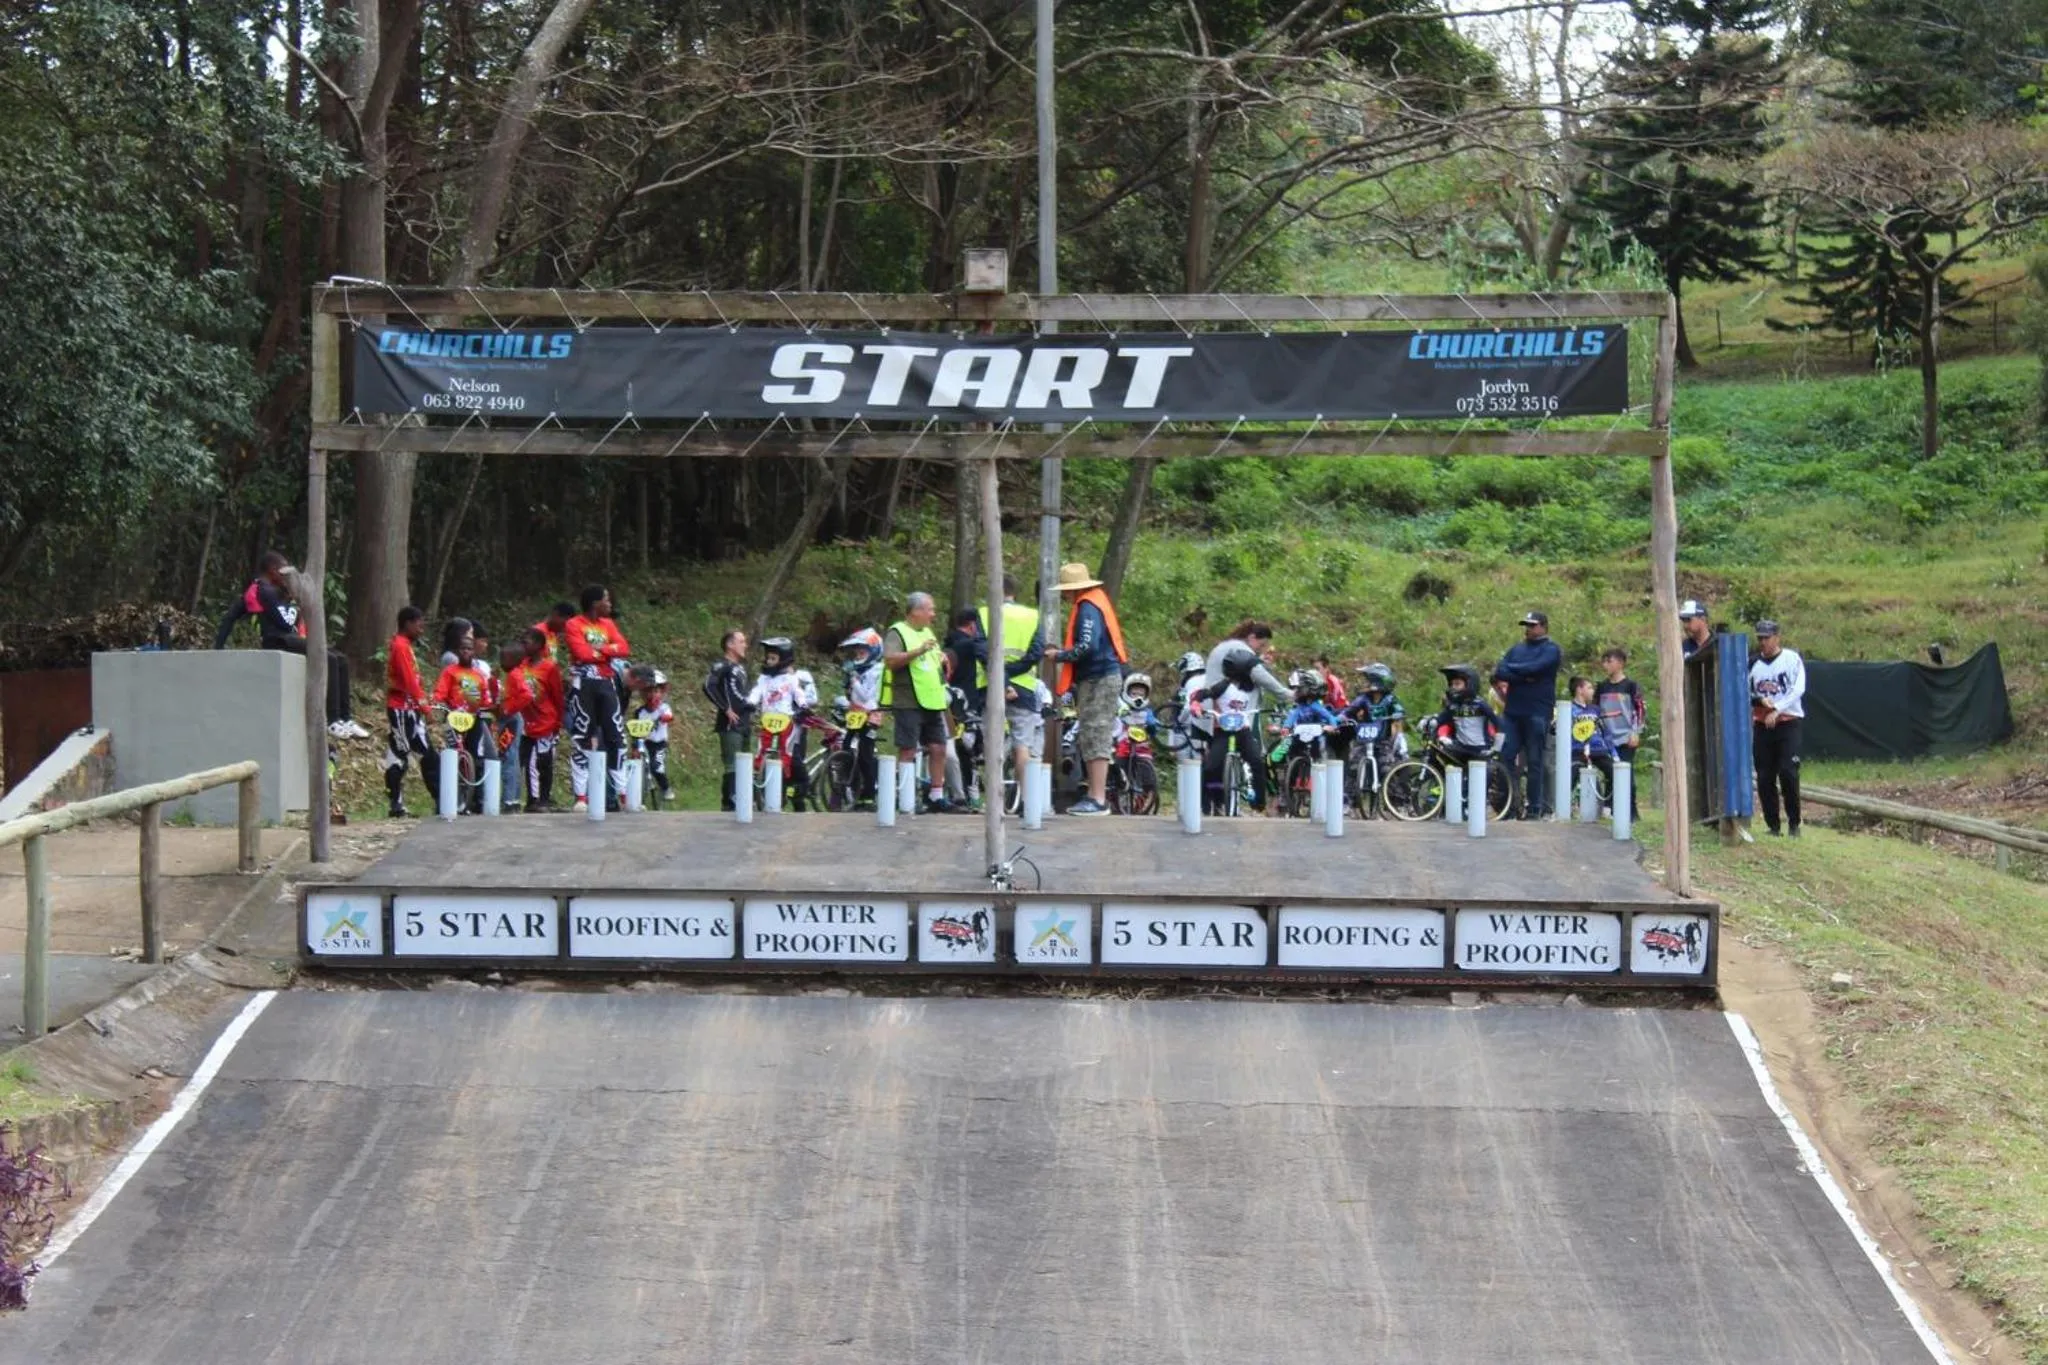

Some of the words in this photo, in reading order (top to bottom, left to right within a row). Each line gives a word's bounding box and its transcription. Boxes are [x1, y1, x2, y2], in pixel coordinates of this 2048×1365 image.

[378, 330, 573, 359] CHURCHILLS
[1408, 330, 1606, 359] CHURCHILLS
[448, 376, 500, 393] Nelson
[761, 343, 1194, 409] START
[1477, 379, 1531, 399] Jordyn
[423, 393, 451, 408] 063
[455, 394, 483, 410] 822
[487, 396, 526, 410] 4940
[1456, 398, 1485, 412] 073
[1489, 397, 1517, 411] 532
[1521, 395, 1559, 411] 3516
[405, 911, 424, 937] 5
[440, 912, 547, 938] STAR
[776, 904, 876, 924] WATER
[1489, 914, 1589, 935] WATER
[575, 916, 700, 937] ROOFING
[709, 917, 729, 937] &
[1113, 919, 1132, 946] 5
[1148, 921, 1255, 947] STAR
[1284, 924, 1410, 947] ROOFING
[1419, 927, 1439, 947] &
[320, 938, 328, 948] 5
[332, 938, 371, 948] STAR
[755, 933, 897, 954] PROOFING
[1027, 947, 1036, 957] 5
[1040, 947, 1079, 957] STAR
[1465, 944, 1609, 965] PROOFING
